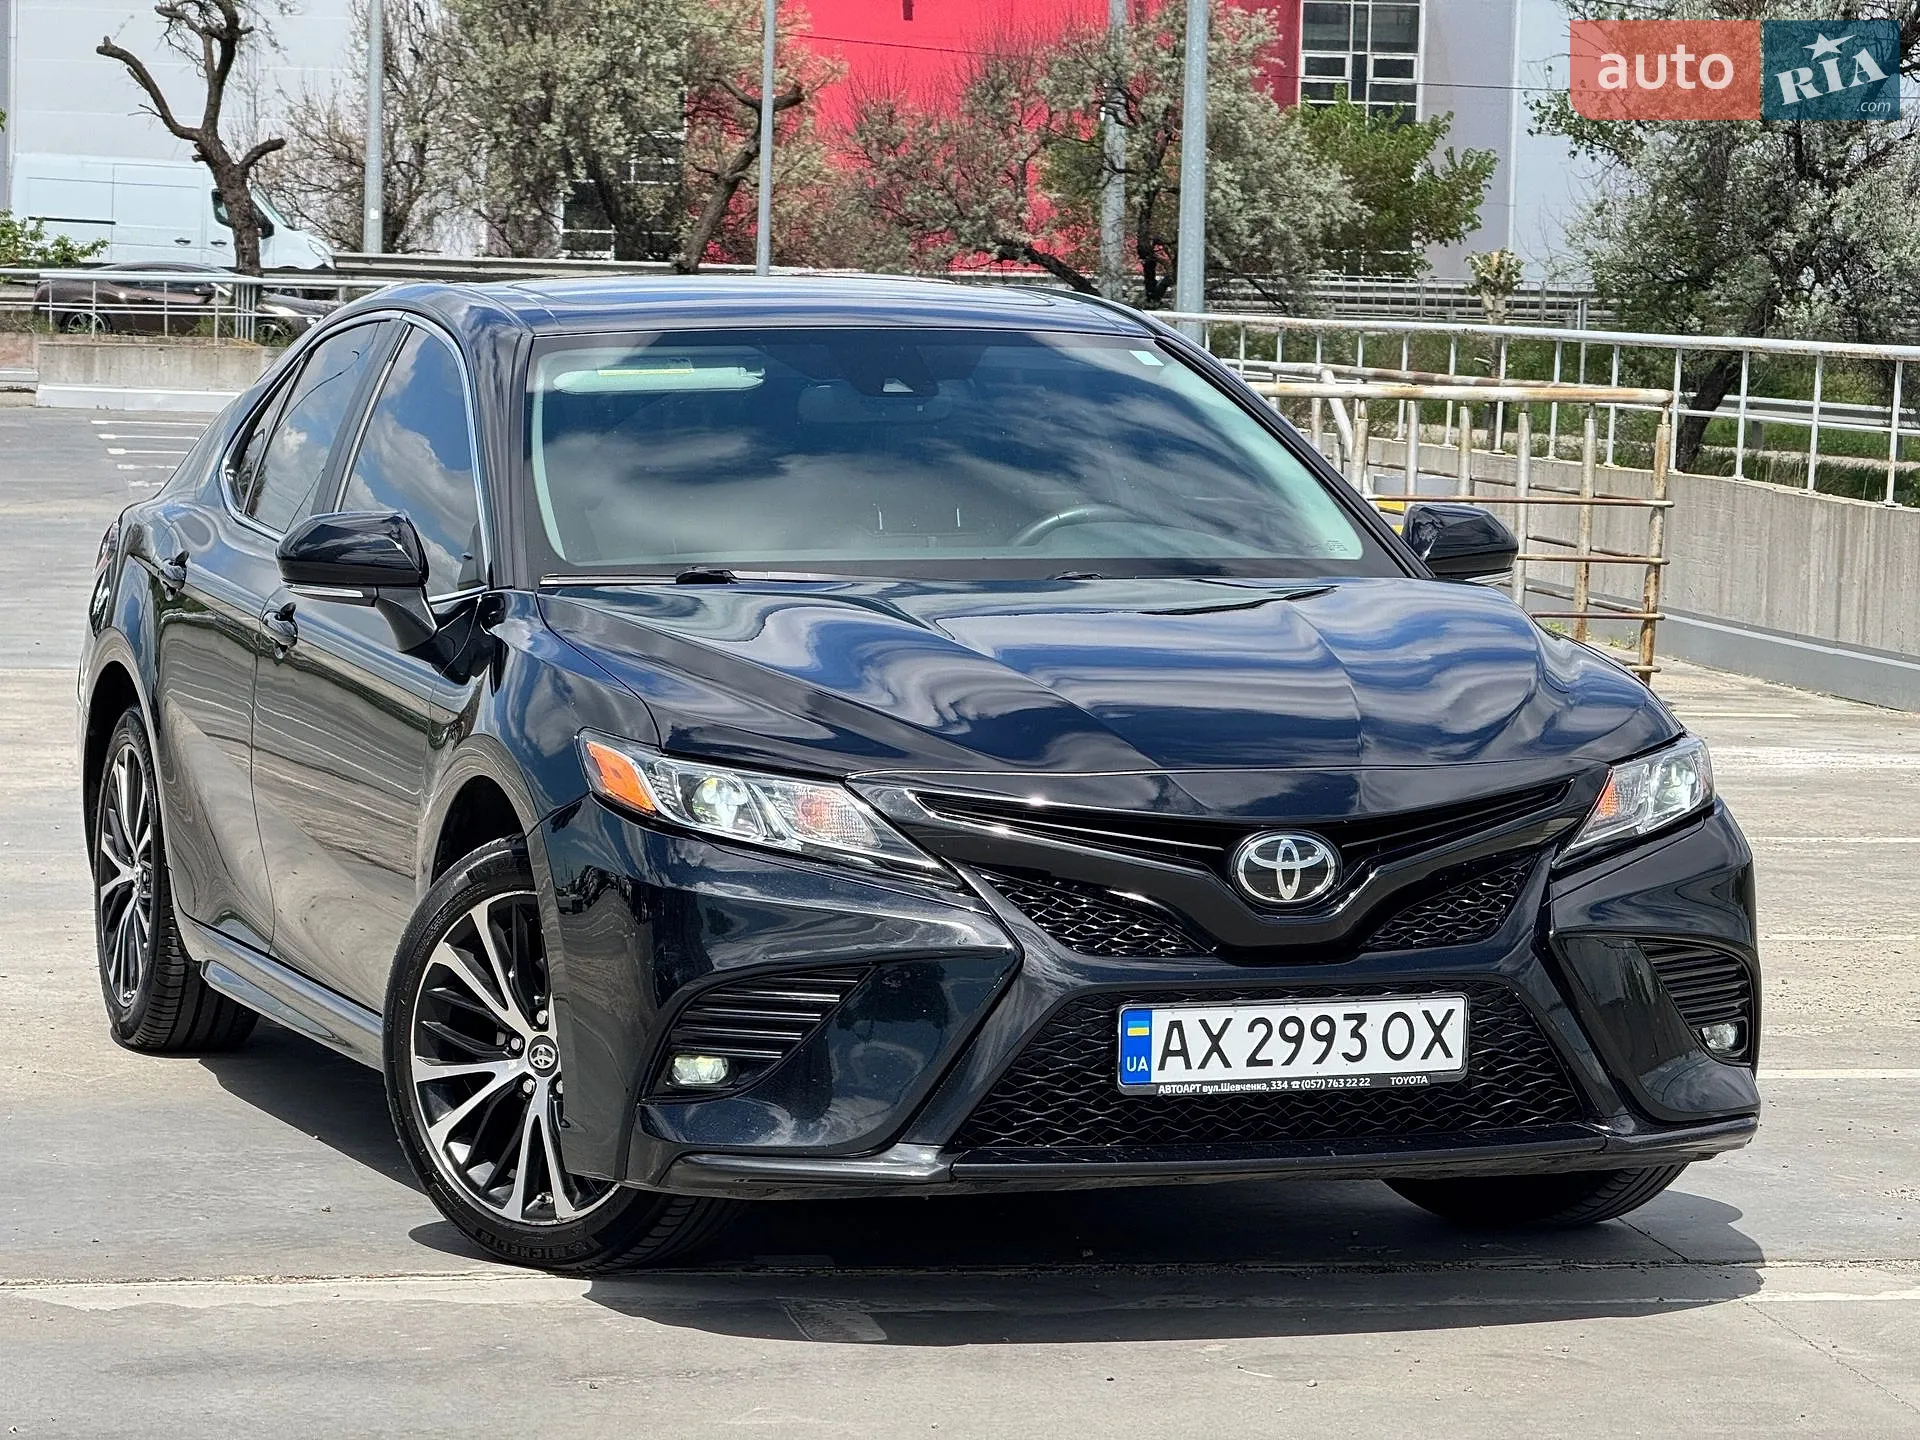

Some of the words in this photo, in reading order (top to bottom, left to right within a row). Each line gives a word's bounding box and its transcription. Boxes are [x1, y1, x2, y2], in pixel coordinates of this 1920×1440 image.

[1157, 1017, 1234, 1071] AX
[1246, 1012, 1368, 1067] 2993
[1381, 1008, 1456, 1061] OX
[1126, 1055, 1149, 1073] UA
[1158, 1083, 1202, 1094] АВТОАРТ
[1270, 1080, 1288, 1090] 334
[1301, 1079, 1326, 1090] (057)
[1327, 1078, 1345, 1088] 763
[1346, 1078, 1358, 1087] 22
[1359, 1077, 1371, 1087] 22
[1390, 1075, 1428, 1086] TOYOTA
